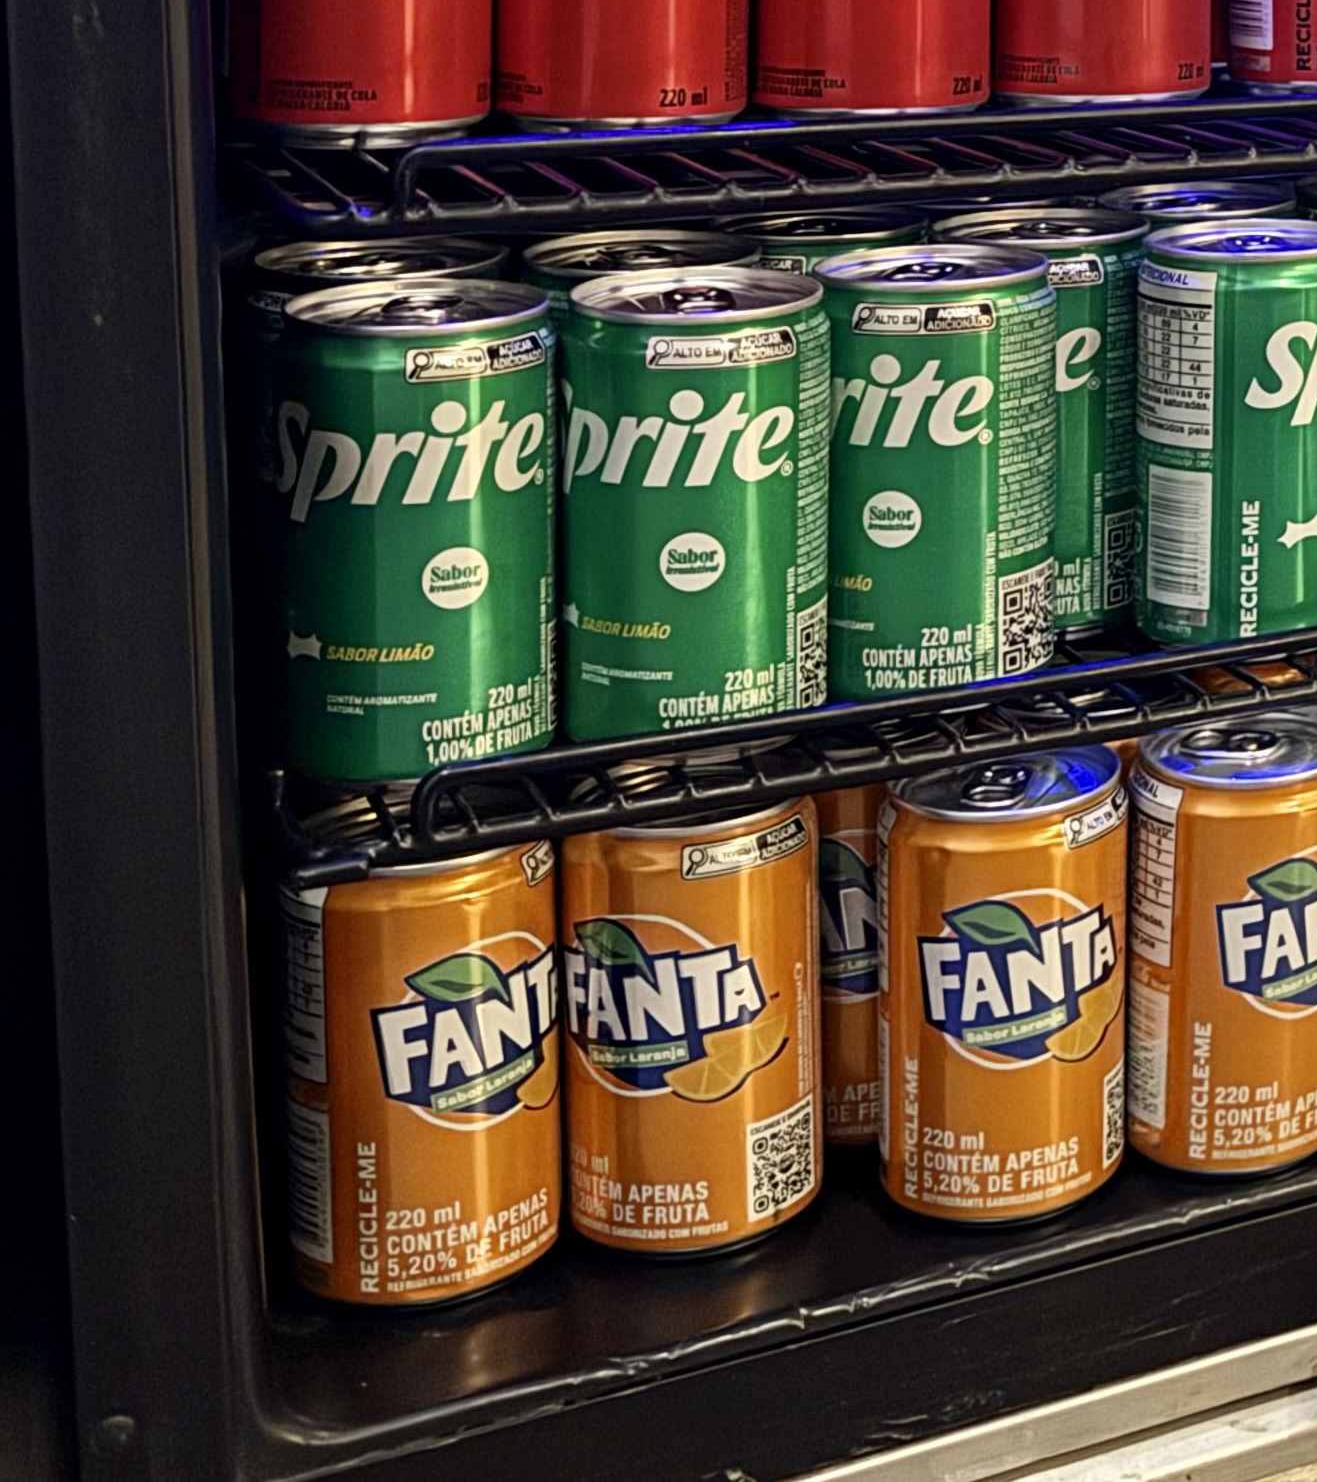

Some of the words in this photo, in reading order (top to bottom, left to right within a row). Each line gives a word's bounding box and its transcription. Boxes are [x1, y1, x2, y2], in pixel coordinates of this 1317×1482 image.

[660, 89, 687, 107] 220
[875, 314, 899, 324] ALTO
[673, 346, 701, 358] ALTO
[832, 353, 994, 449] rite
[275, 400, 546, 524] Sprite
[868, 505, 914, 522] Sabor
[666, 546, 718, 566] Sabor
[1239, 500, 1261, 638] RECICLE-ME
[429, 560, 482, 585] Sabor
[623, 622, 671, 640] LIMÃO
[920, 627, 950, 647] 220
[953, 624, 972, 644] ml
[327, 646, 378, 661] SABOR
[380, 644, 434, 662] LIMÃO
[862, 645, 917, 668] CONTÉM
[919, 647, 973, 667] APENAS
[724, 668, 751, 691] 220
[756, 663, 774, 688] ml
[908, 669, 927, 688] DE
[929, 665, 973, 687] FRUTA
[488, 684, 513, 708] 220
[516, 677, 532, 702] ml
[659, 690, 719, 718] CONTÉM
[723, 686, 775, 713] APENAS
[423, 715, 483, 743] CONTÉM
[475, 736, 494, 756] DE
[496, 724, 533, 754] FRUTA
[921, 910, 1115, 1021] FANTA
[564, 949, 766, 1042] FANTA
[965, 1026, 1008, 1045] Sabor
[1190, 1022, 1213, 1159] RECICLE-ME
[1215, 1085, 1249, 1106] 220
[1254, 1082, 1278, 1101] ml
[904, 1055, 919, 1198] RECICLE-ME
[1214, 1102, 1290, 1126] CONTÉM
[923, 1127, 956, 1150] 220
[961, 1128, 984, 1150] ml
[1213, 1125, 1272, 1146] 5,20%
[1278, 1120, 1300, 1140] DE
[923, 1149, 1001, 1175] CONTÉM
[1007, 1138, 1079, 1172] APENAS
[923, 1173, 980, 1194] 5,20%
[988, 1173, 1013, 1193] DE
[1018, 1160, 1079, 1190] FRUTA
[629, 1182, 708, 1203] APENAS
[358, 1142, 379, 1294] RECICLE-ME
[386, 1206, 426, 1231] 220
[433, 1201, 461, 1222] ml
[386, 1223, 478, 1256] CONTÉM
[483, 1189, 548, 1237] APENAS
[613, 1204, 637, 1223] DE
[643, 1203, 709, 1222] FRUTA
[387, 1246, 457, 1277] 5,20%
[466, 1238, 493, 1263] DE
[499, 1210, 549, 1251] FRUTA
